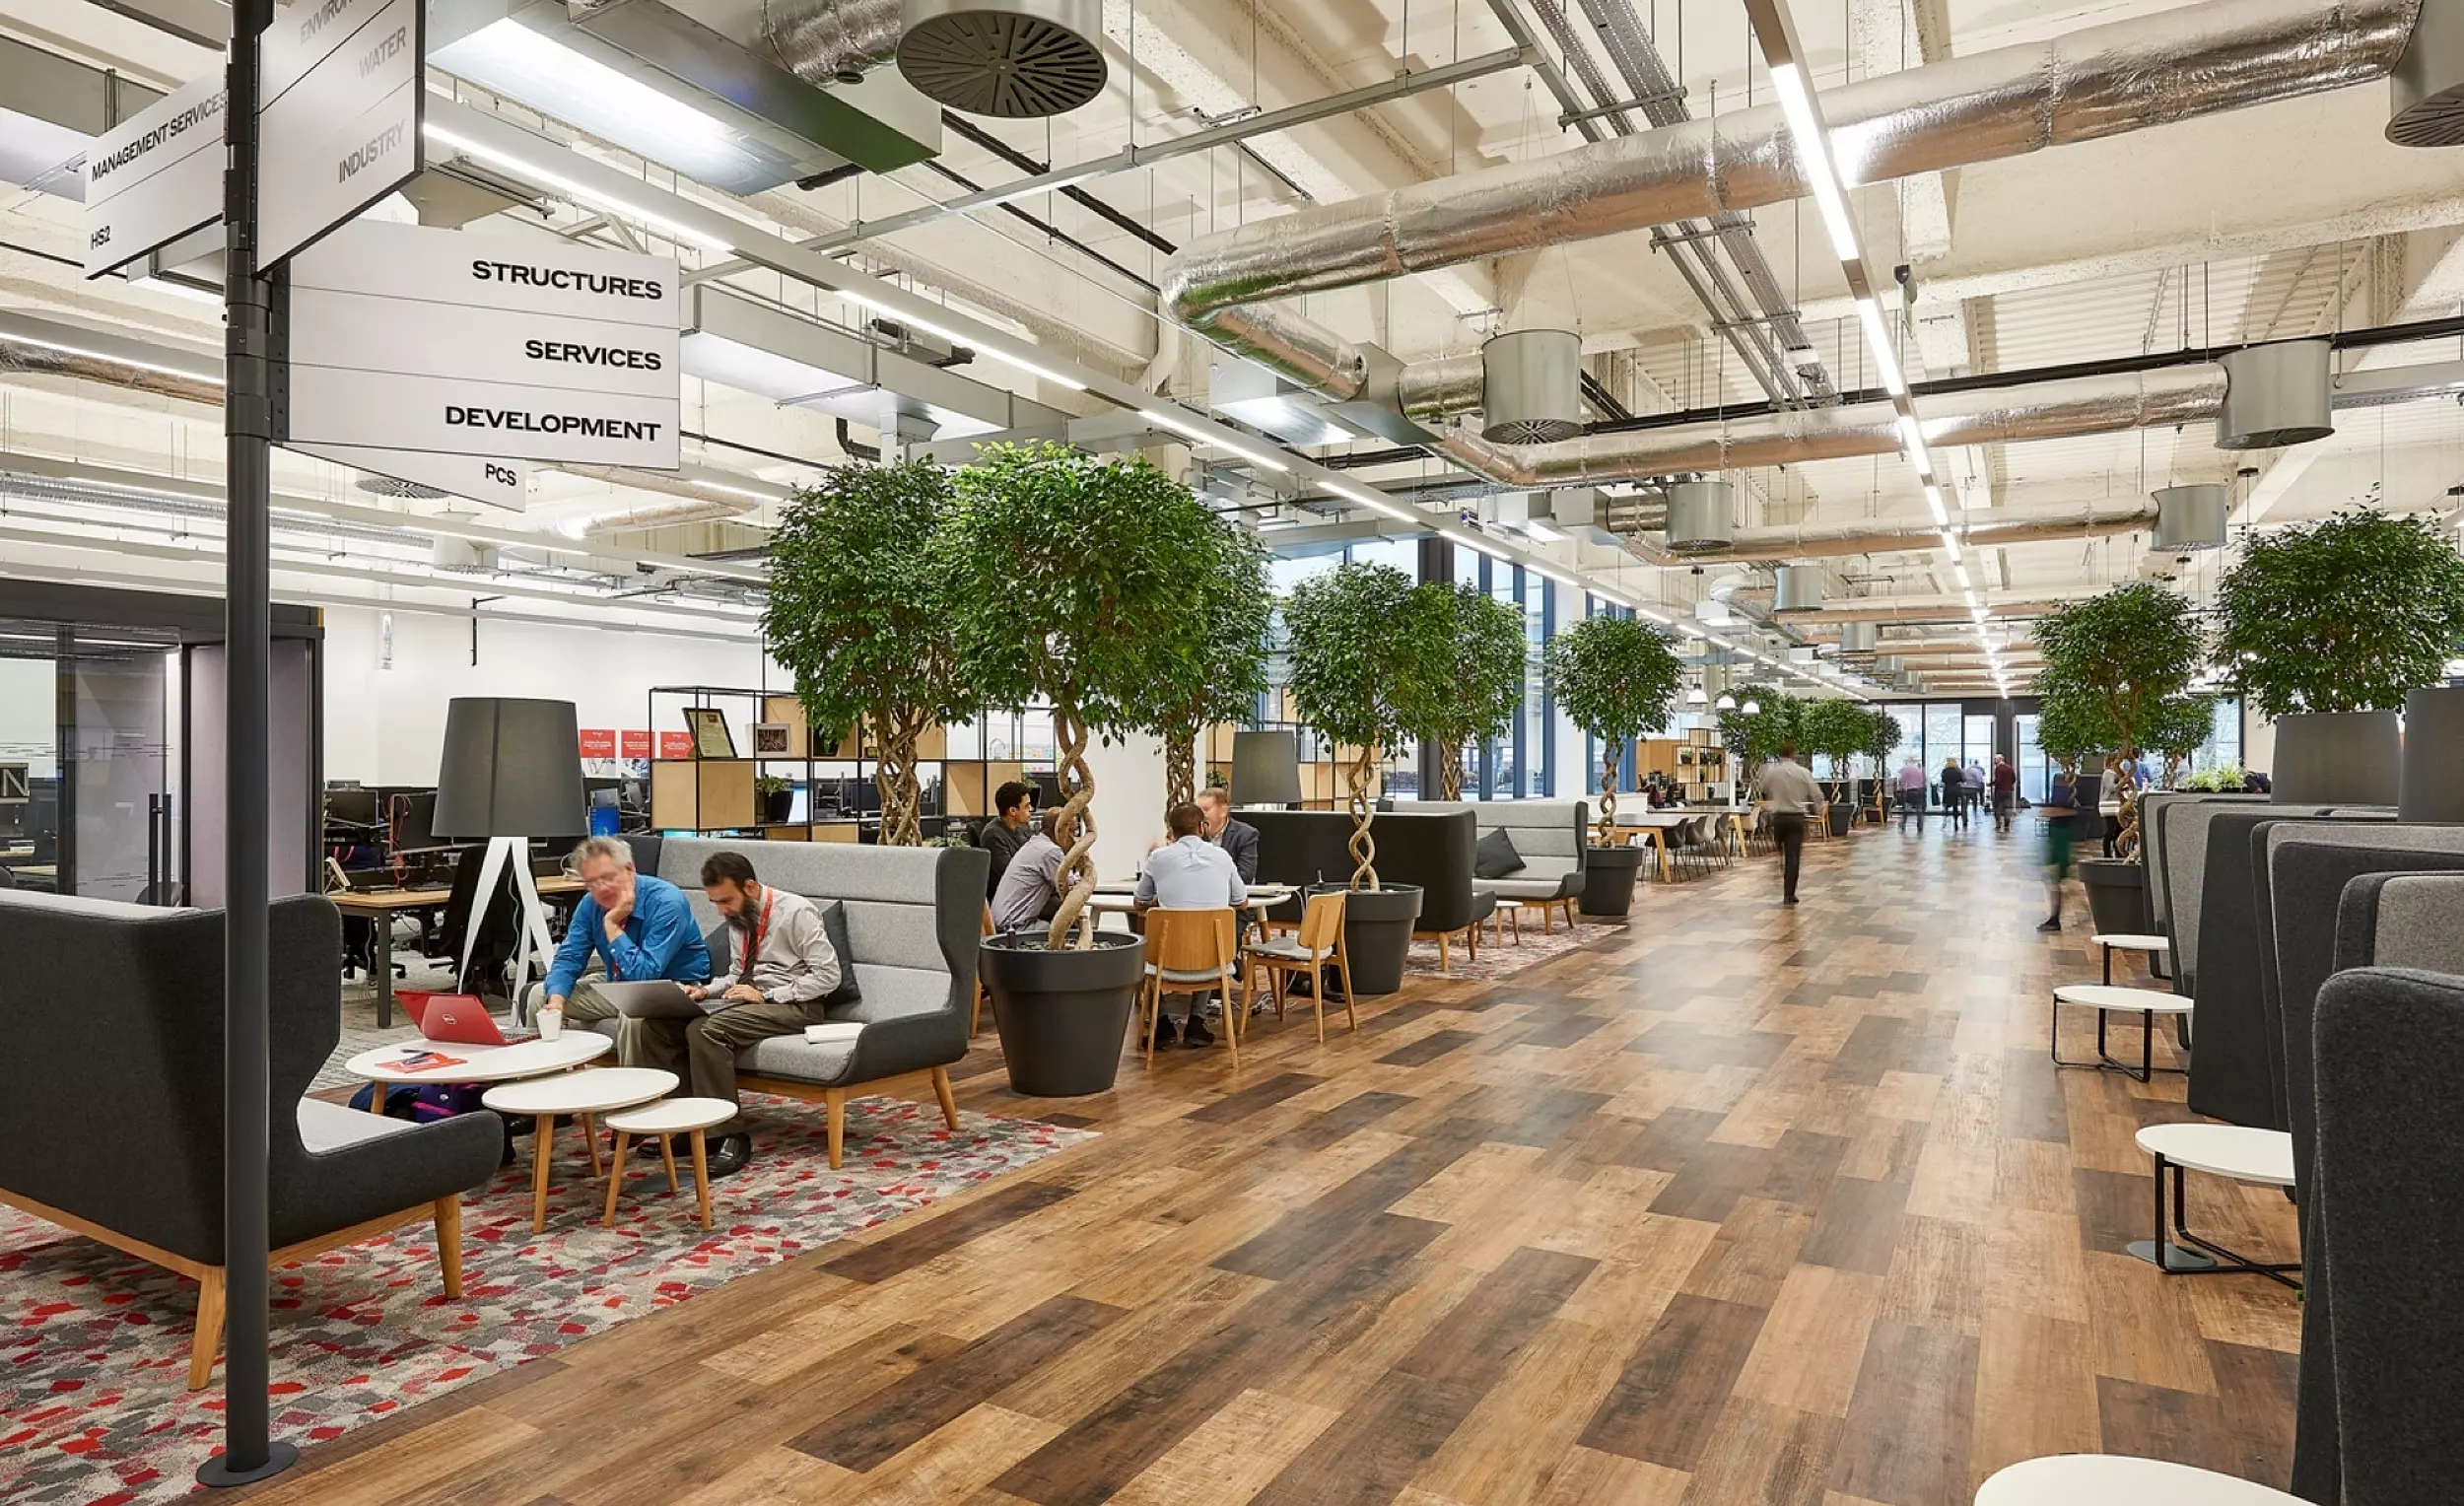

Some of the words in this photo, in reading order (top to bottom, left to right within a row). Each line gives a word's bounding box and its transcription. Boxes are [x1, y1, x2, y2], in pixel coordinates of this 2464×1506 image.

[359, 26, 406, 80] WATER
[92, 123, 169, 181] MANAGEMENT
[170, 91, 228, 137] SERVICES
[339, 118, 405, 183] INDUSTRY
[91, 225, 110, 249] HS2
[472, 260, 662, 300] STRUCTURES
[525, 339, 661, 371] SERVICES
[445, 406, 661, 442] DEVELOPMENT
[485, 462, 517, 487] PCS
